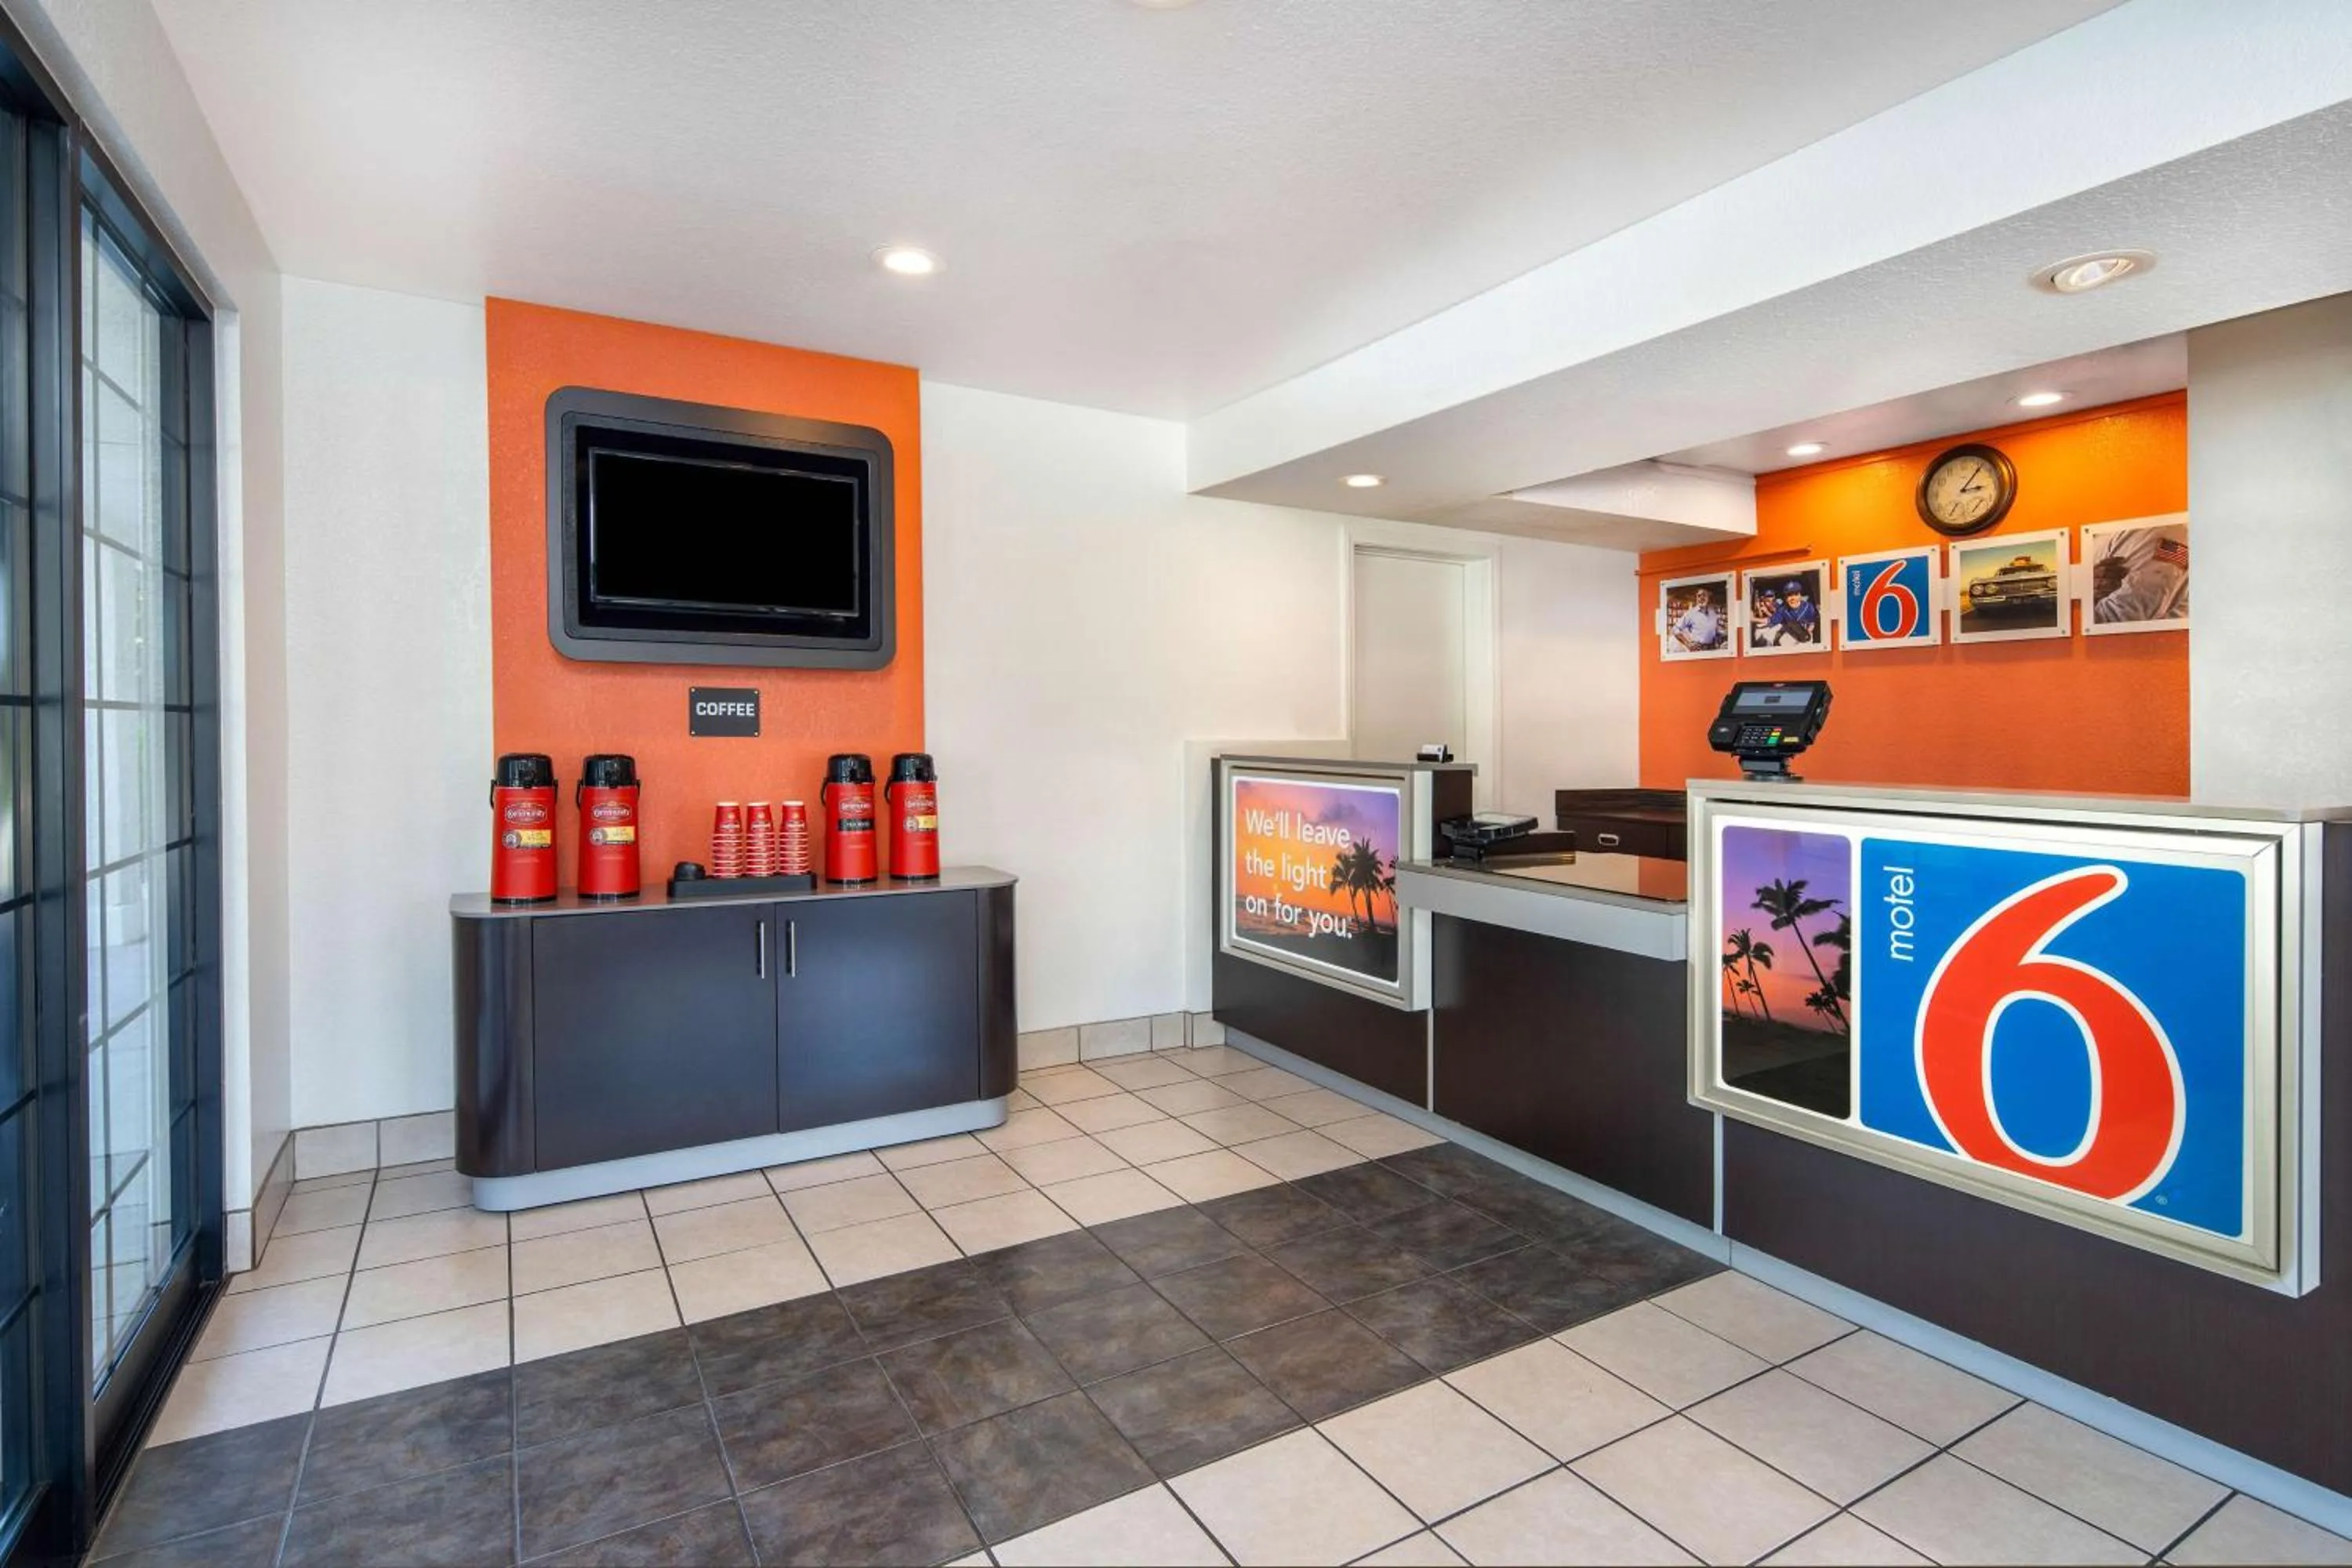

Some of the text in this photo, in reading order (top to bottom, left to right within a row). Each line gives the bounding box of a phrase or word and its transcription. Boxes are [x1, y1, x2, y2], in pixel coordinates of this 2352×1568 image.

[1852, 560, 1918, 641] motel 6
[695, 702, 756, 717] COFFEE
[1245, 808, 1351, 848] We'll leave
[1245, 849, 1327, 892] the light
[1245, 893, 1353, 939] on for you.
[1882, 864, 2186, 1206] motel 6
